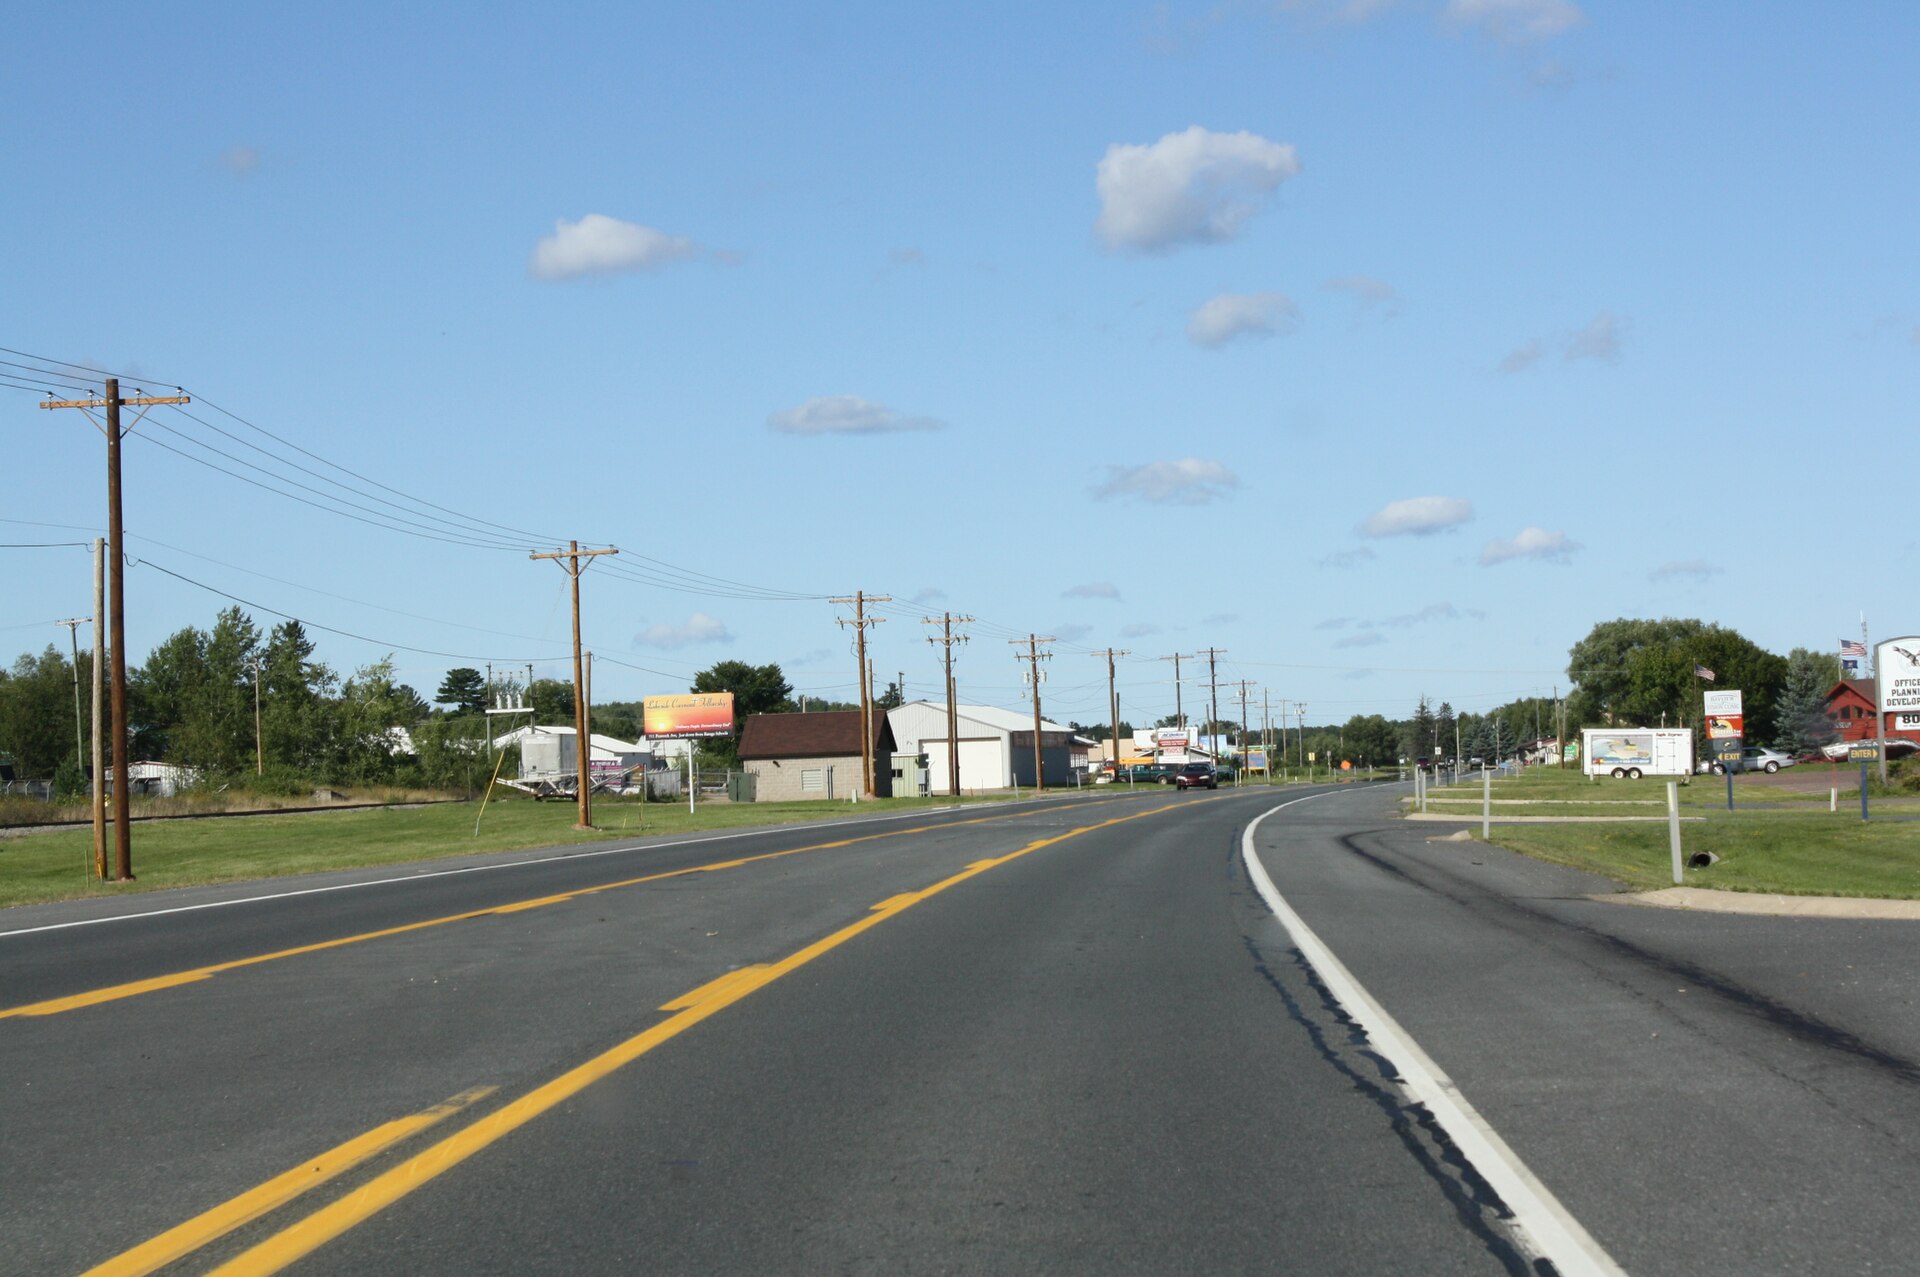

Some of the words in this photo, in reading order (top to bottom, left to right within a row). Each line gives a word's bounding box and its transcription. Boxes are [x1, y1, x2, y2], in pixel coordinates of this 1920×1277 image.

[1895, 679, 1920, 687] OFFICE
[1724, 752, 1740, 760] EXIT
[1850, 749, 1872, 758] ENTER
